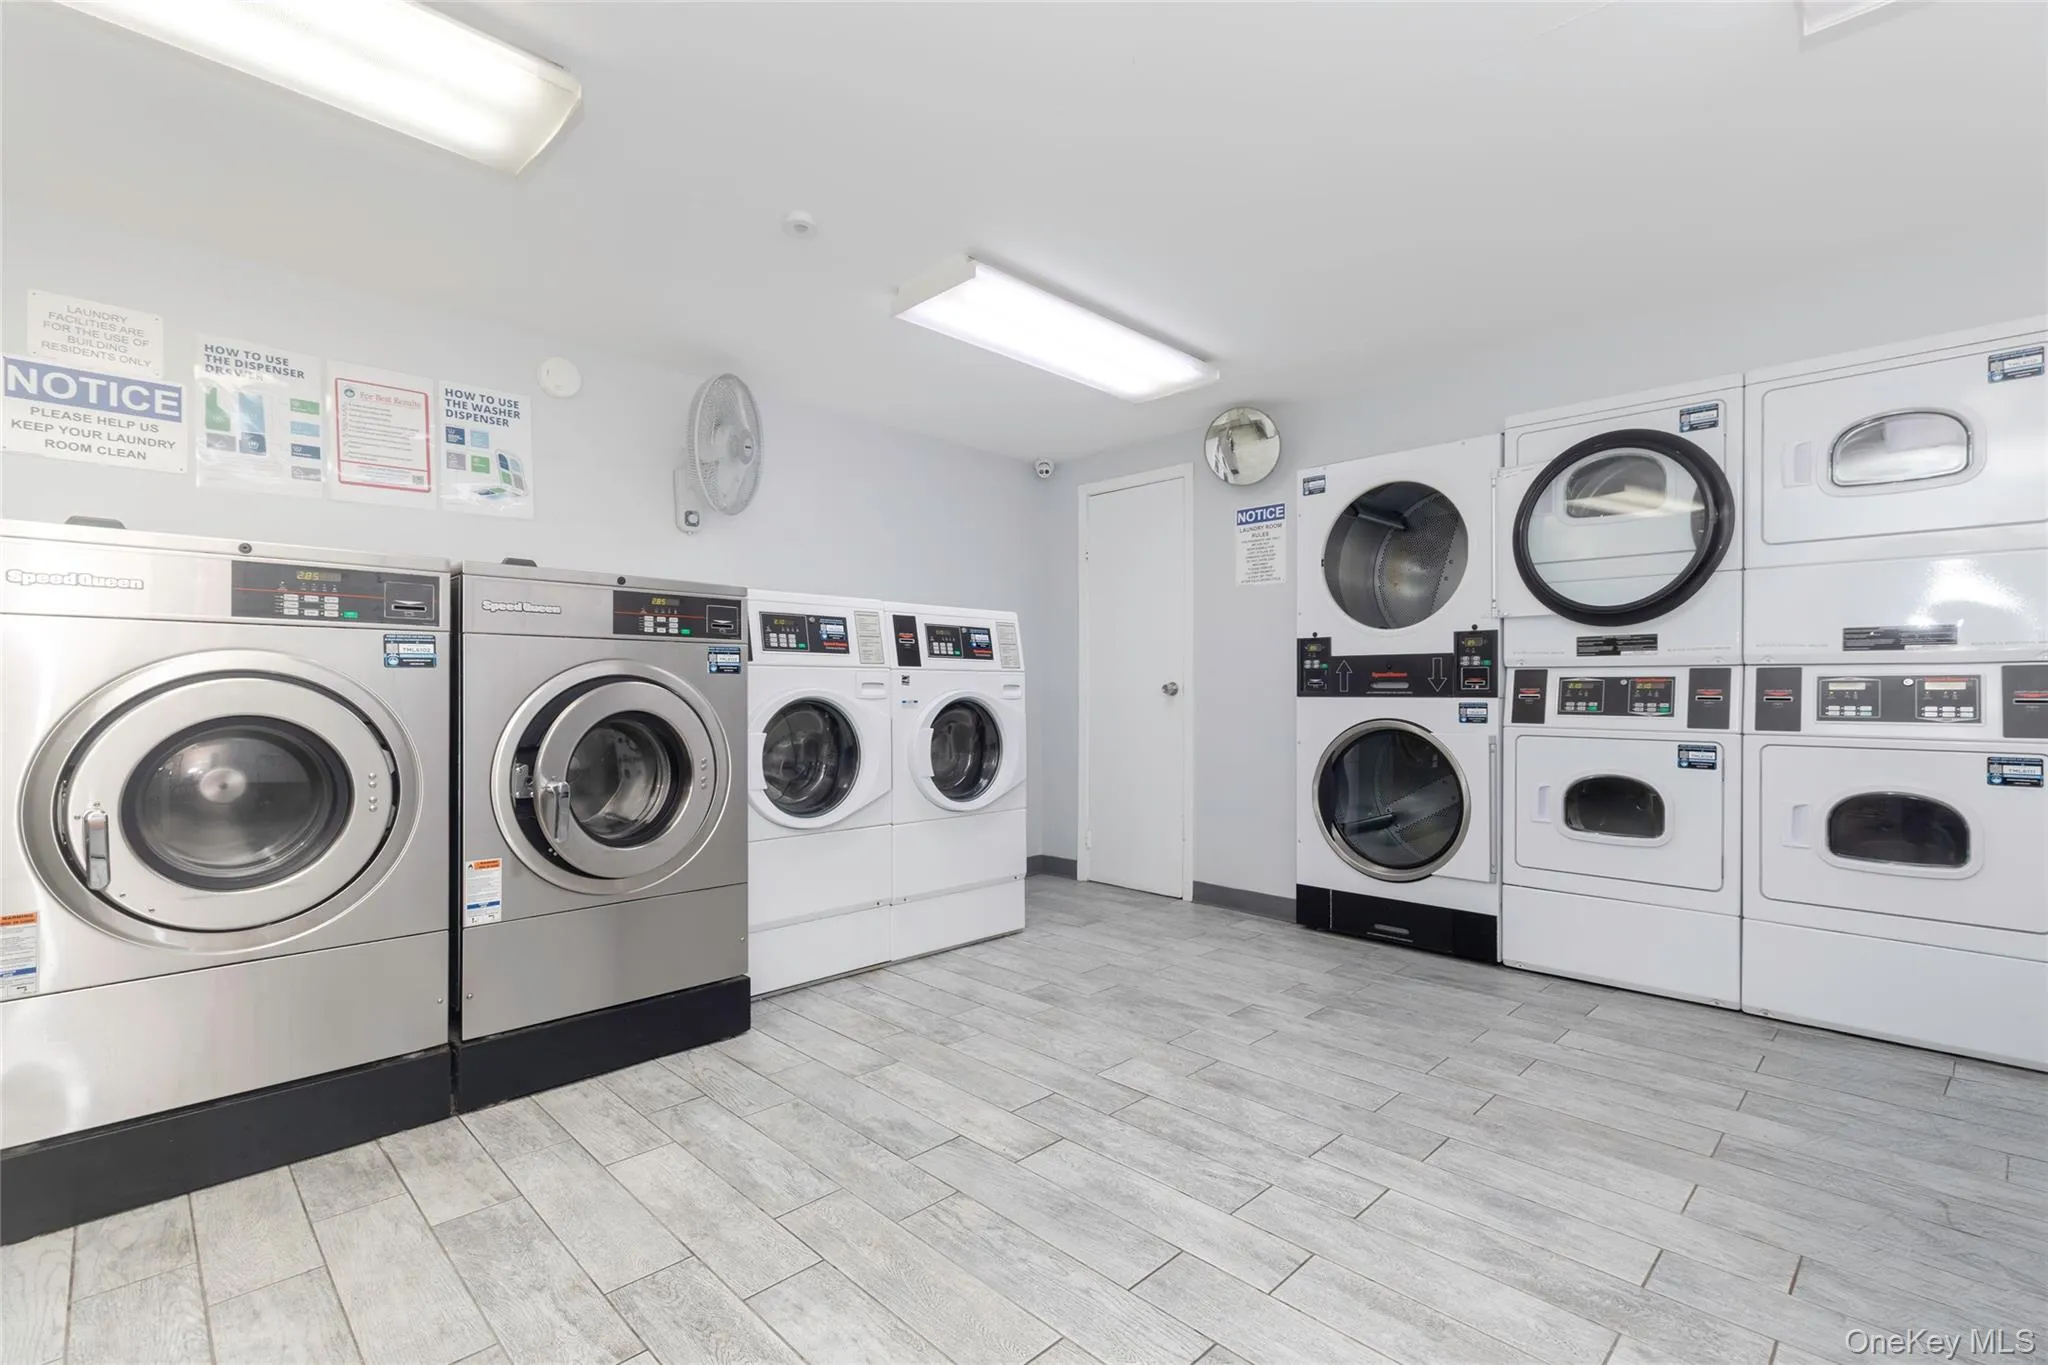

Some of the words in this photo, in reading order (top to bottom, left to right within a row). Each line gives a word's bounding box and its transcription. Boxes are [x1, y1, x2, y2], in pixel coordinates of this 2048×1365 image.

[48, 311, 117, 332] FACILITIES
[119, 326, 145, 338] ARE
[66, 305, 128, 323] LAUNDRY
[43, 320, 71, 333] FOR
[74, 326, 100, 339] THE
[103, 332, 129, 345] USE
[132, 337, 150, 347] OF
[67, 335, 128, 353] BUILDING
[41, 340, 116, 362] RESIDENTS
[119, 355, 152, 368] ONLY
[204, 343, 240, 357] HOW
[243, 350, 262, 361] TO
[265, 354, 289, 367] USE
[204, 353, 231, 366] THE
[234, 359, 305, 379] DISPENSER
[7, 364, 180, 417] NOTICE
[445, 388, 476, 401] HOW
[479, 394, 494, 405] TO
[498, 398, 520, 410] USE
[30, 406, 92, 424] PLEASE
[96, 415, 136, 429] HELP
[139, 422, 160, 433] US
[445, 398, 468, 410] THE
[471, 402, 520, 419] WASHER
[446, 408, 509, 427] DISPENSER
[11, 418, 54, 433] KEEP
[58, 425, 103, 440] YOUR
[107, 432, 176, 450] LAUNDRY
[44, 439, 92, 453] ROOM
[96, 446, 147, 461] CLEAN
[1238, 506, 1284, 523] NOTICE
[1240, 524, 1263, 534] LAUNDRY
[6, 569, 79, 586] Speed
[481, 600, 523, 613] Speed
